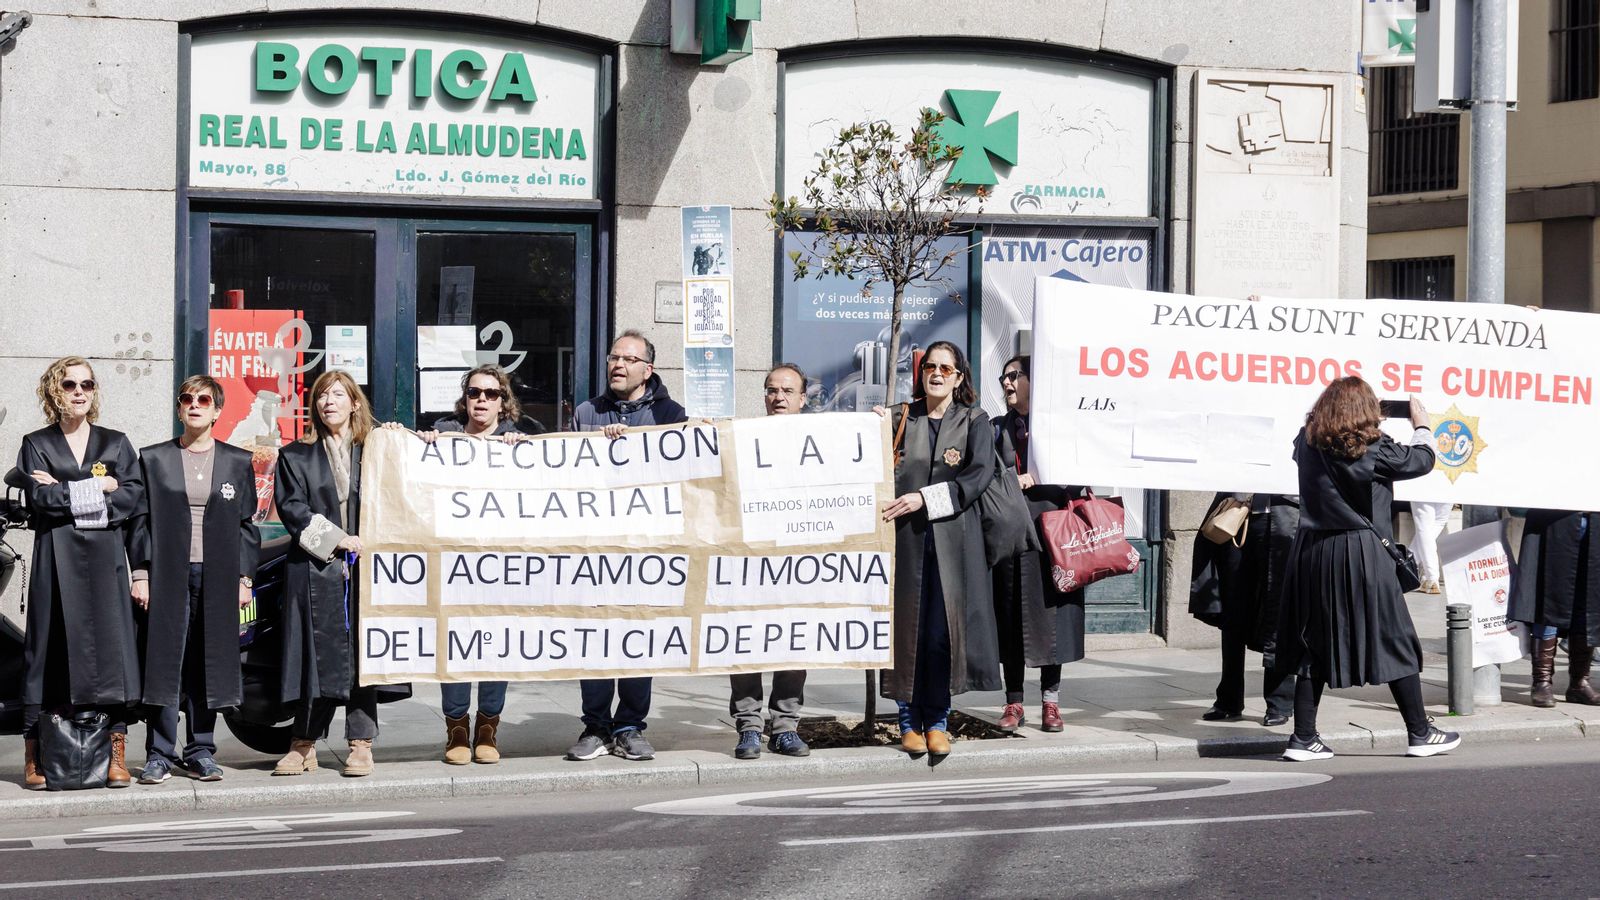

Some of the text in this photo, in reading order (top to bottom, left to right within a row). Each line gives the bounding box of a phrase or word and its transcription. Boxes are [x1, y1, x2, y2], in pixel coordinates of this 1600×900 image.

[254, 41, 536, 104] BOTICA
[199, 113, 587, 161] REAL DE LA ALMUDENA
[199, 160, 287, 177] Mayor, 88
[395, 168, 587, 187] Ldo. J. Gómez del Río
[1024, 184, 1104, 199] FARMACIA
[984, 239, 1143, 268] ATM Cajero
[813, 292, 938, 308] ¿Y si pudieras evejecer
[816, 308, 836, 319] dos
[839, 310, 872, 320] veces
[901, 310, 935, 321] ento?
[1151, 304, 1549, 350] PACTA SUNT SERVANDA
[1079, 346, 1592, 405] LOS ACUERDOS SE CUMPLEN
[1078, 397, 1116, 411] LAJs
[421, 424, 719, 468] ADECUACIÓN
[452, 487, 682, 519] SALARIAL
[743, 494, 873, 513] LETRADOS ADMÓN DE
[786, 521, 834, 533] JUSTICIA
[374, 552, 889, 587] NO ACEPTAMOS LIMOSNA
[1471, 574, 1476, 582] A
[1479, 571, 1489, 581] LA
[367, 627, 435, 662] DEL
[497, 625, 688, 661] JUSTICIA
[705, 620, 890, 654] DEPENDE
